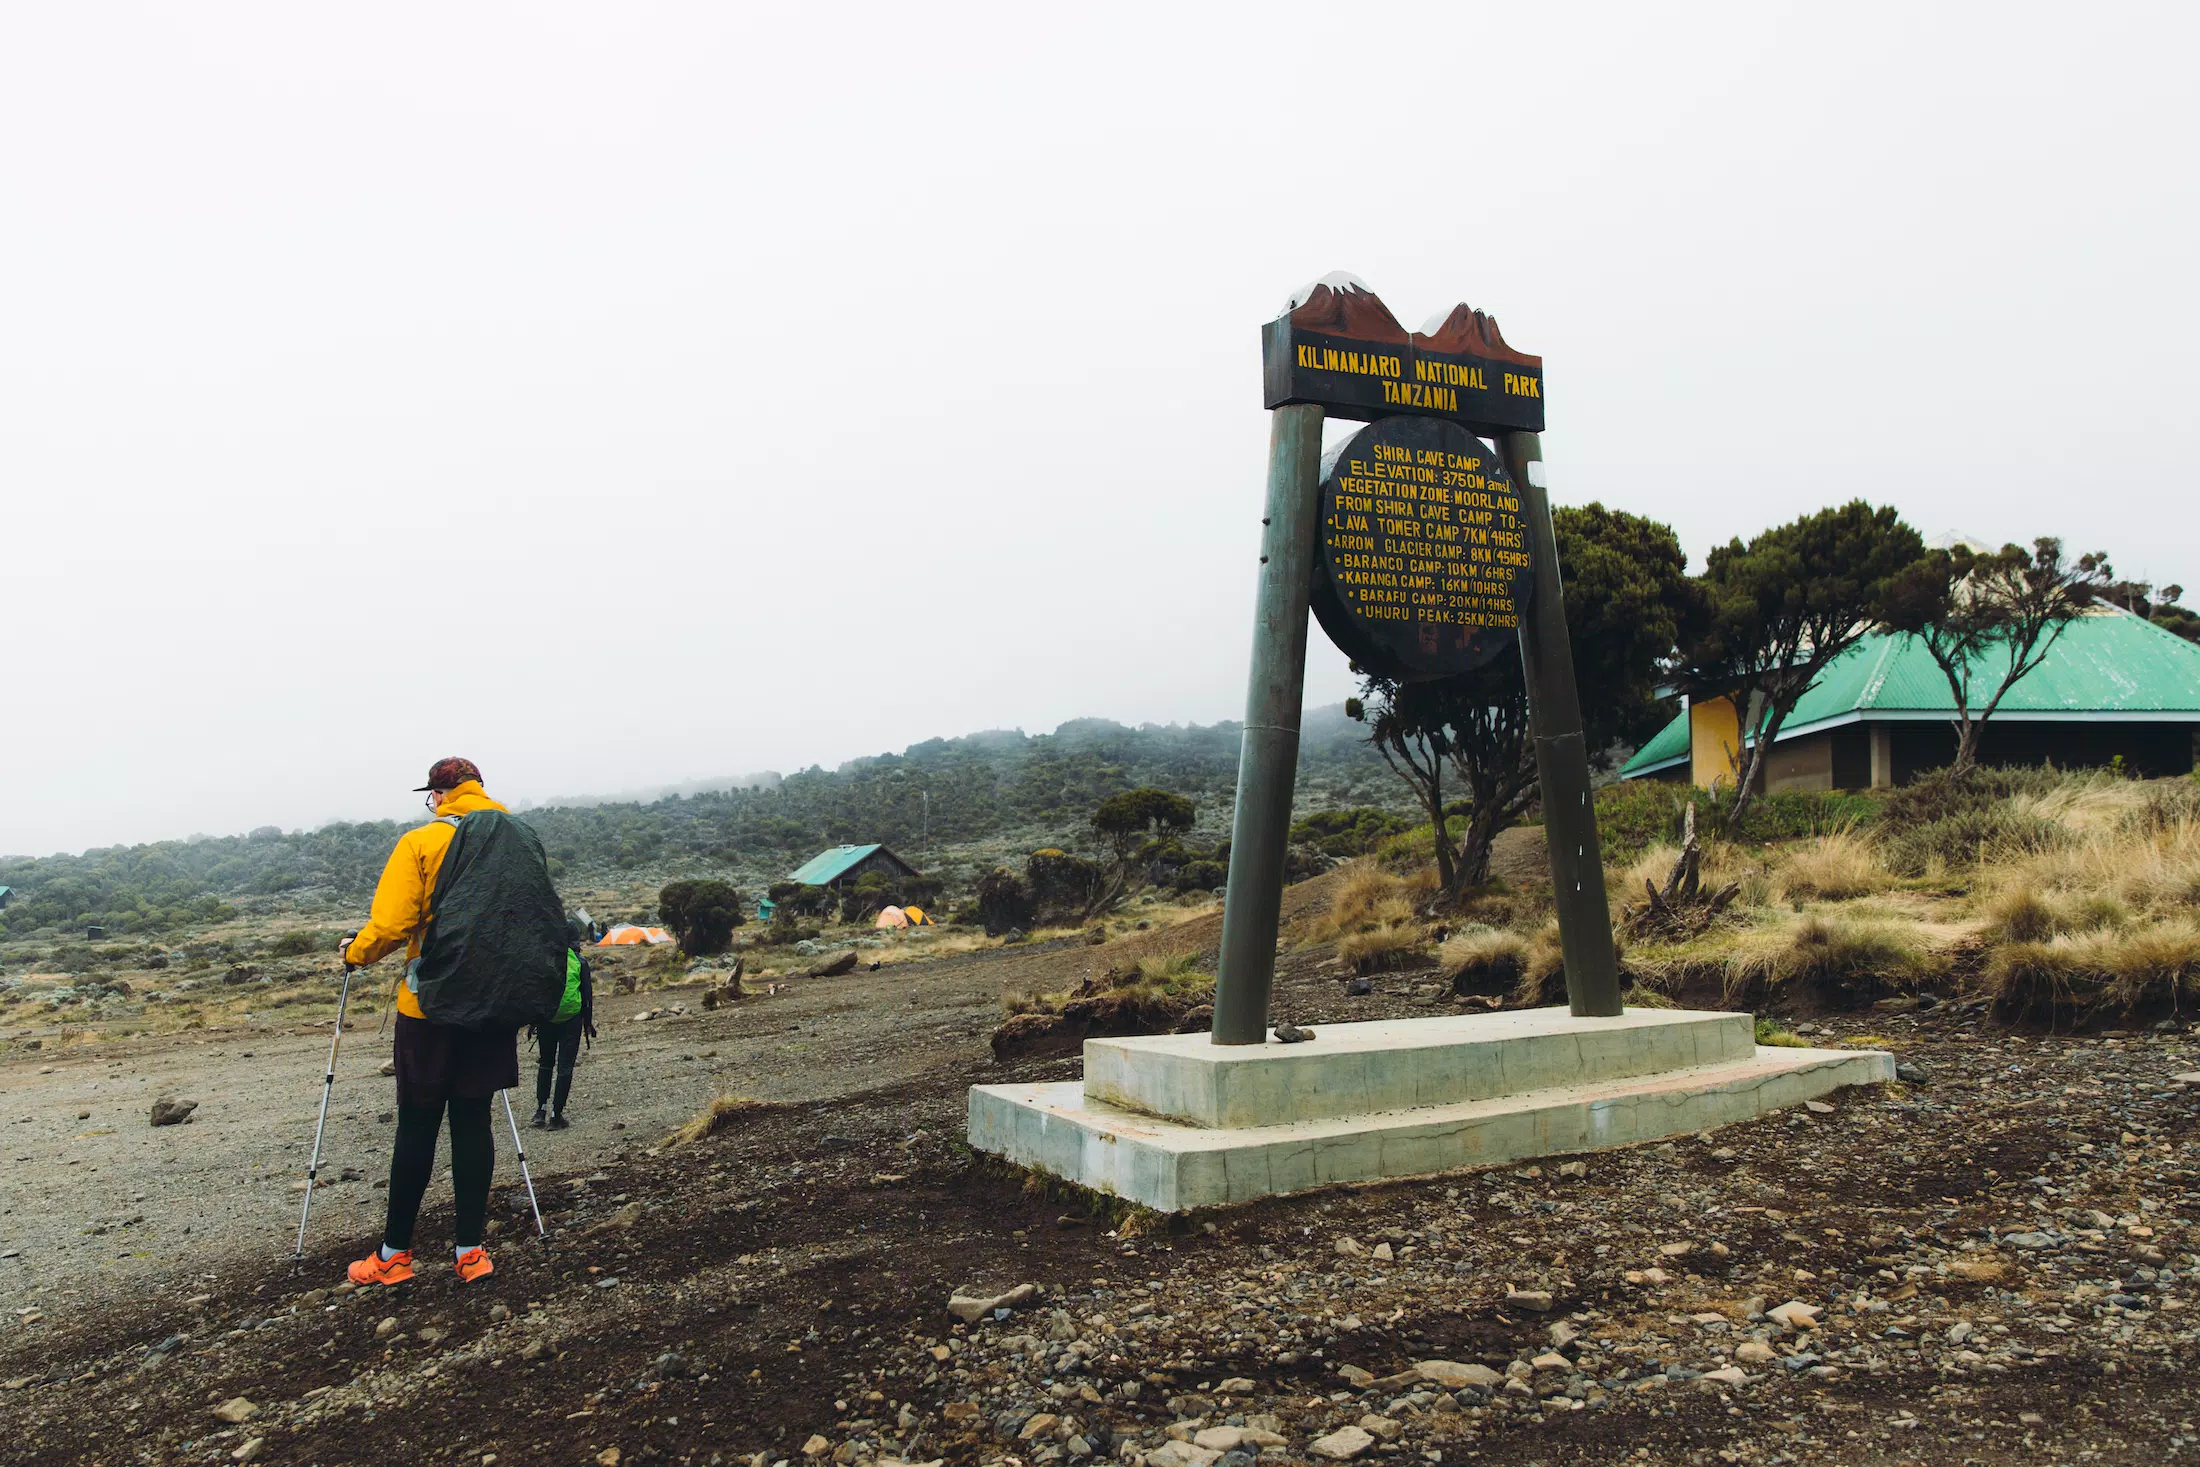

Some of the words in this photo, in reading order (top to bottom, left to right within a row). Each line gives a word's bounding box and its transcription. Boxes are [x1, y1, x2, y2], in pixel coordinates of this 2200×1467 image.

[1297, 344, 1401, 378] KILIMANJARO
[1415, 359, 1488, 390] NATIONAL
[1503, 372, 1540, 398] PARK
[1382, 380, 1458, 412] TANZANIA
[1373, 444, 1412, 463] SHIRA
[1416, 449, 1445, 468] CAVE
[1447, 453, 1480, 472] CAMP
[1339, 476, 1417, 500] VEGETATION
[1350, 459, 1438, 484] ELEVATION:
[1442, 470, 1485, 490] 3750M
[1487, 479, 1511, 494] amsl
[1335, 495, 1372, 513] FROM
[1375, 500, 1414, 517] SHIRA
[1420, 504, 1450, 522] CAVE
[1458, 508, 1493, 526] CAMP
[1377, 517, 1421, 538] TOWER
[1425, 523, 1459, 542] CAMP
[1384, 538, 1432, 558] GLACIER
[1435, 543, 1466, 560] CAMP:
[1409, 559, 1445, 574] CAMP:
[1447, 562, 1477, 578] 10KM
[1400, 574, 1435, 590] CAMP:
[1360, 588, 1407, 603] BARAFU
[1411, 592, 1447, 606] CAMP:
[1365, 605, 1409, 621] UHURU
[1418, 608, 1455, 624] PEAK:
